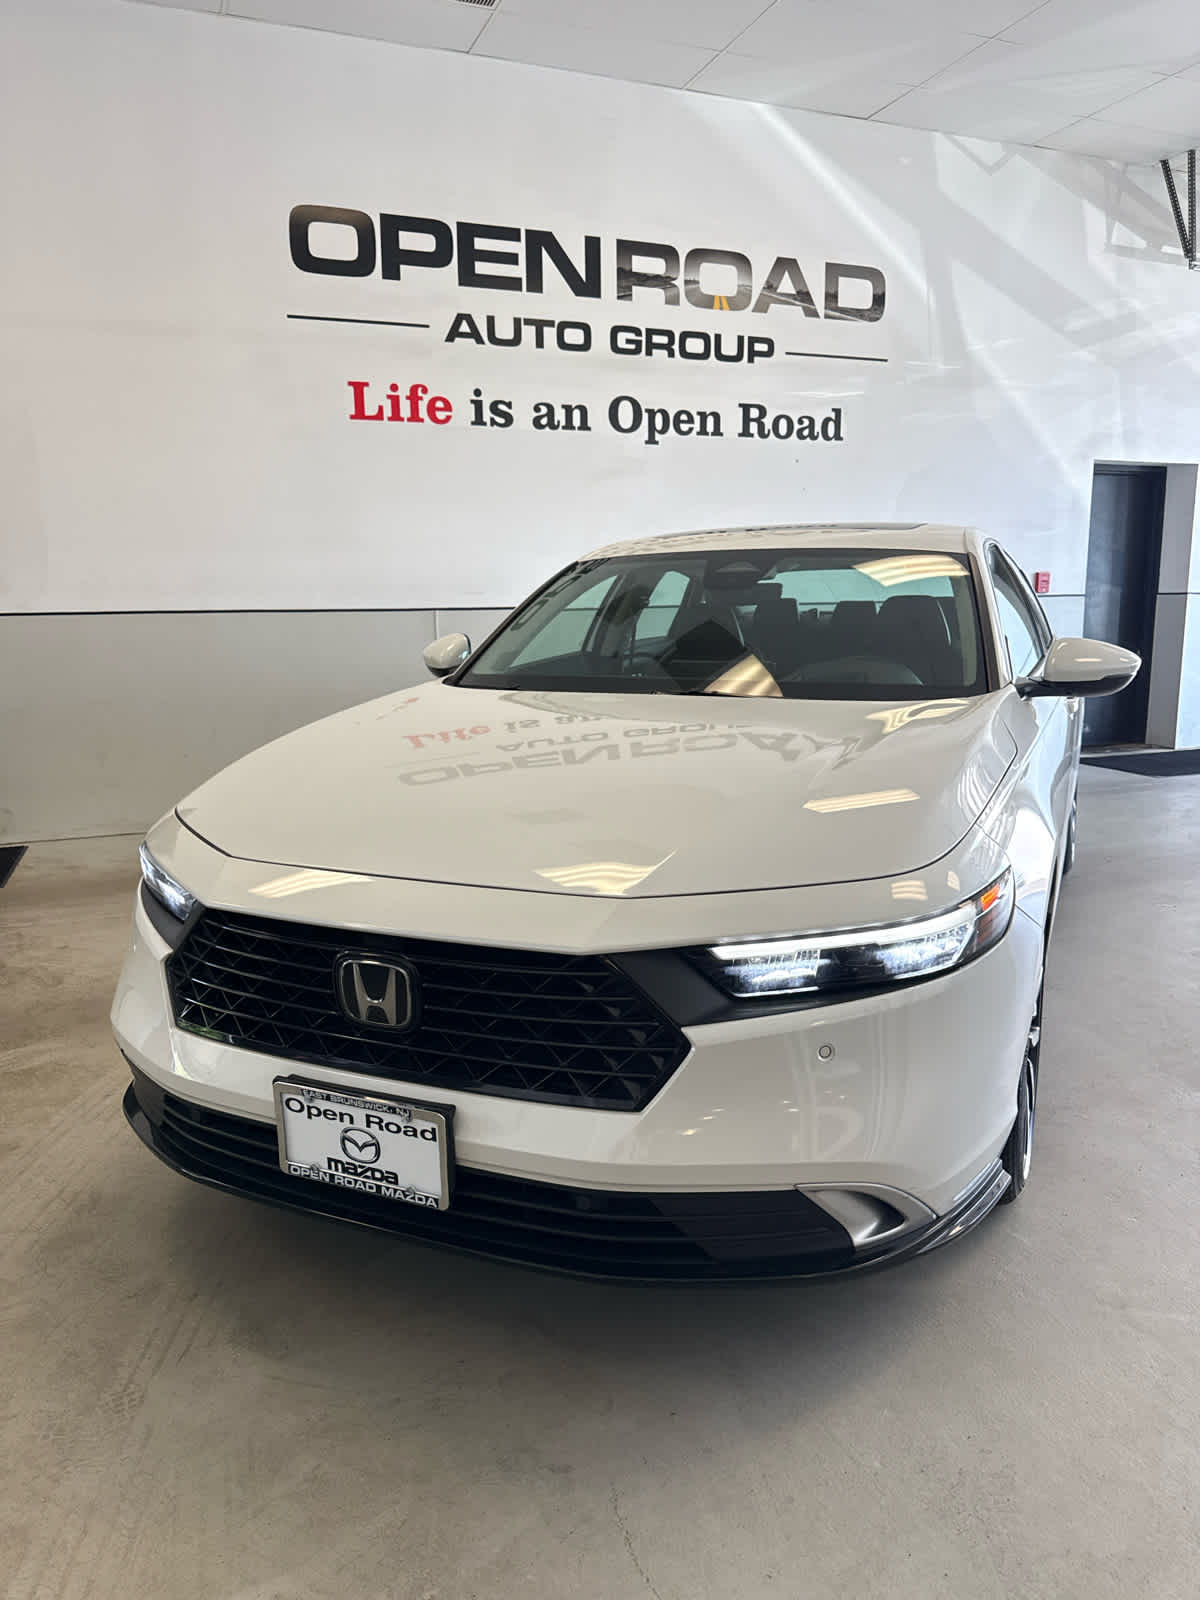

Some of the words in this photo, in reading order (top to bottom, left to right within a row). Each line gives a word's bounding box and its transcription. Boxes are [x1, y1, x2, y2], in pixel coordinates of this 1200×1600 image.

[289, 204, 602, 299] OPEN
[615, 238, 886, 323] ROAD
[444, 313, 592, 352] AUTO
[609, 325, 775, 364] GROUP
[347, 380, 453, 425] Life
[470, 388, 514, 428] is
[532, 400, 591, 431] an
[608, 396, 724, 445] Open
[737, 403, 844, 442] Road
[303, 1089, 327, 1100] EAST
[284, 1097, 354, 1125] Open
[365, 1113, 438, 1142] Road
[290, 1165, 330, 1182] OPEN
[334, 1175, 376, 1193] ROAD
[381, 1186, 438, 1209] MAZDA
